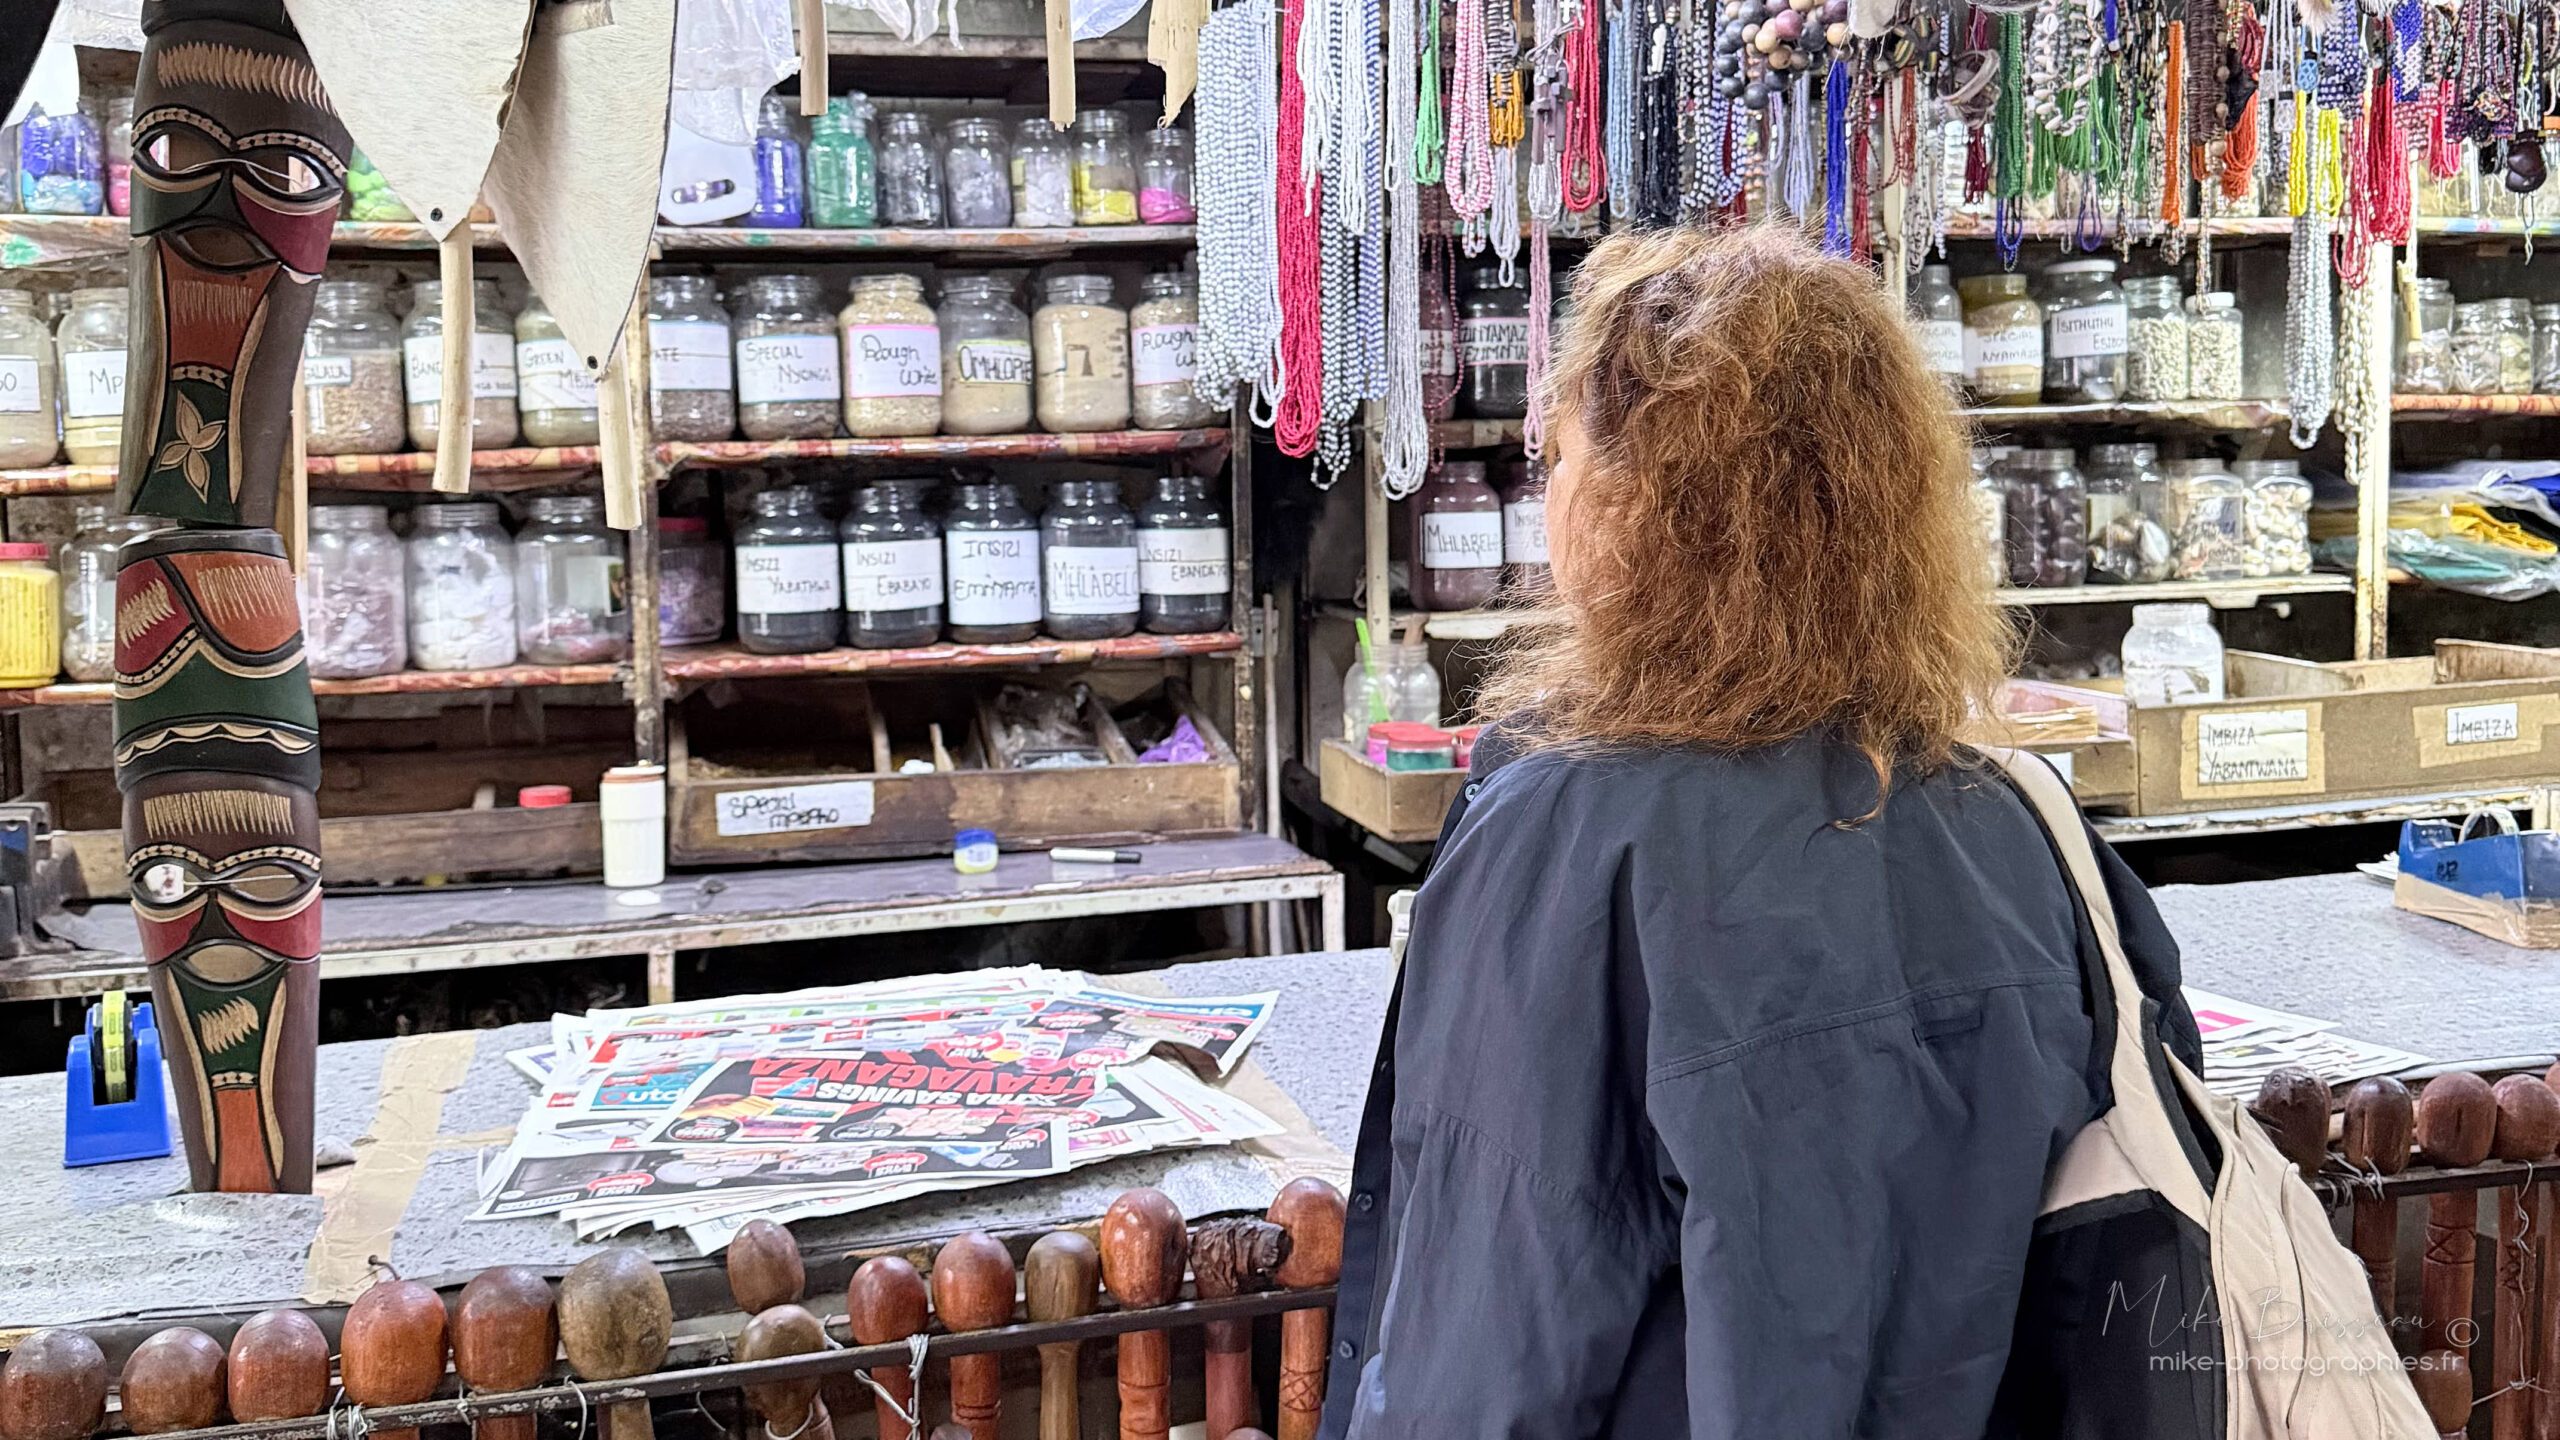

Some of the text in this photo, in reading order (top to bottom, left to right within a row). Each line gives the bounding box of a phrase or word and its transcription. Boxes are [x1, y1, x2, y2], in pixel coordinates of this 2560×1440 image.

[2206, 724, 2256, 746] IMBIZA
[2454, 712, 2515, 743] IMBIZA
[2206, 753, 2299, 780] YABANTWANA
[814, 1081, 962, 1106] SAVINGS
